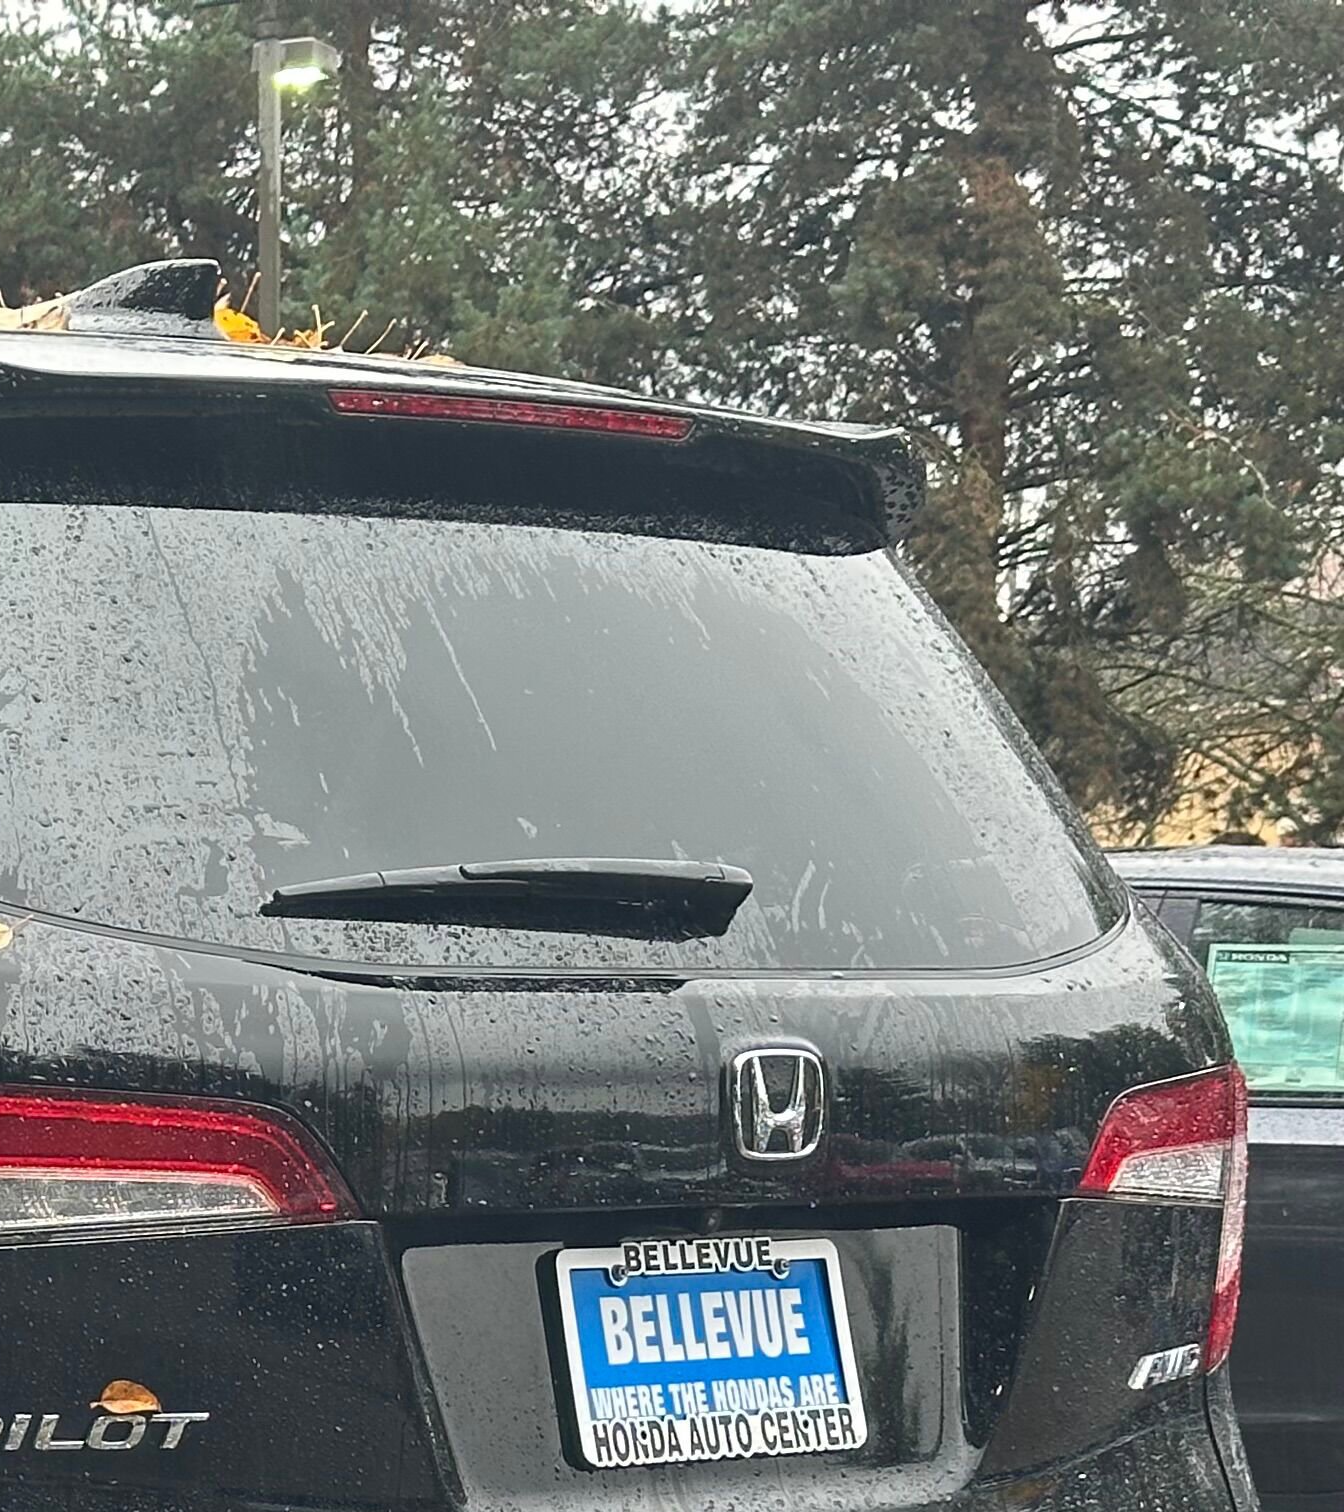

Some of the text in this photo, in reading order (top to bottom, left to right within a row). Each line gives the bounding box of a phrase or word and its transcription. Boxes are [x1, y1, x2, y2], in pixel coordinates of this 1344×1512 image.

[623, 1239, 772, 1272] BELLEVUE
[599, 1288, 811, 1366] BELLEVUE
[590, 1373, 840, 1419] WHERE THE HONDAS ARE
[592, 1408, 858, 1462] HONDA AUTO CENTER
